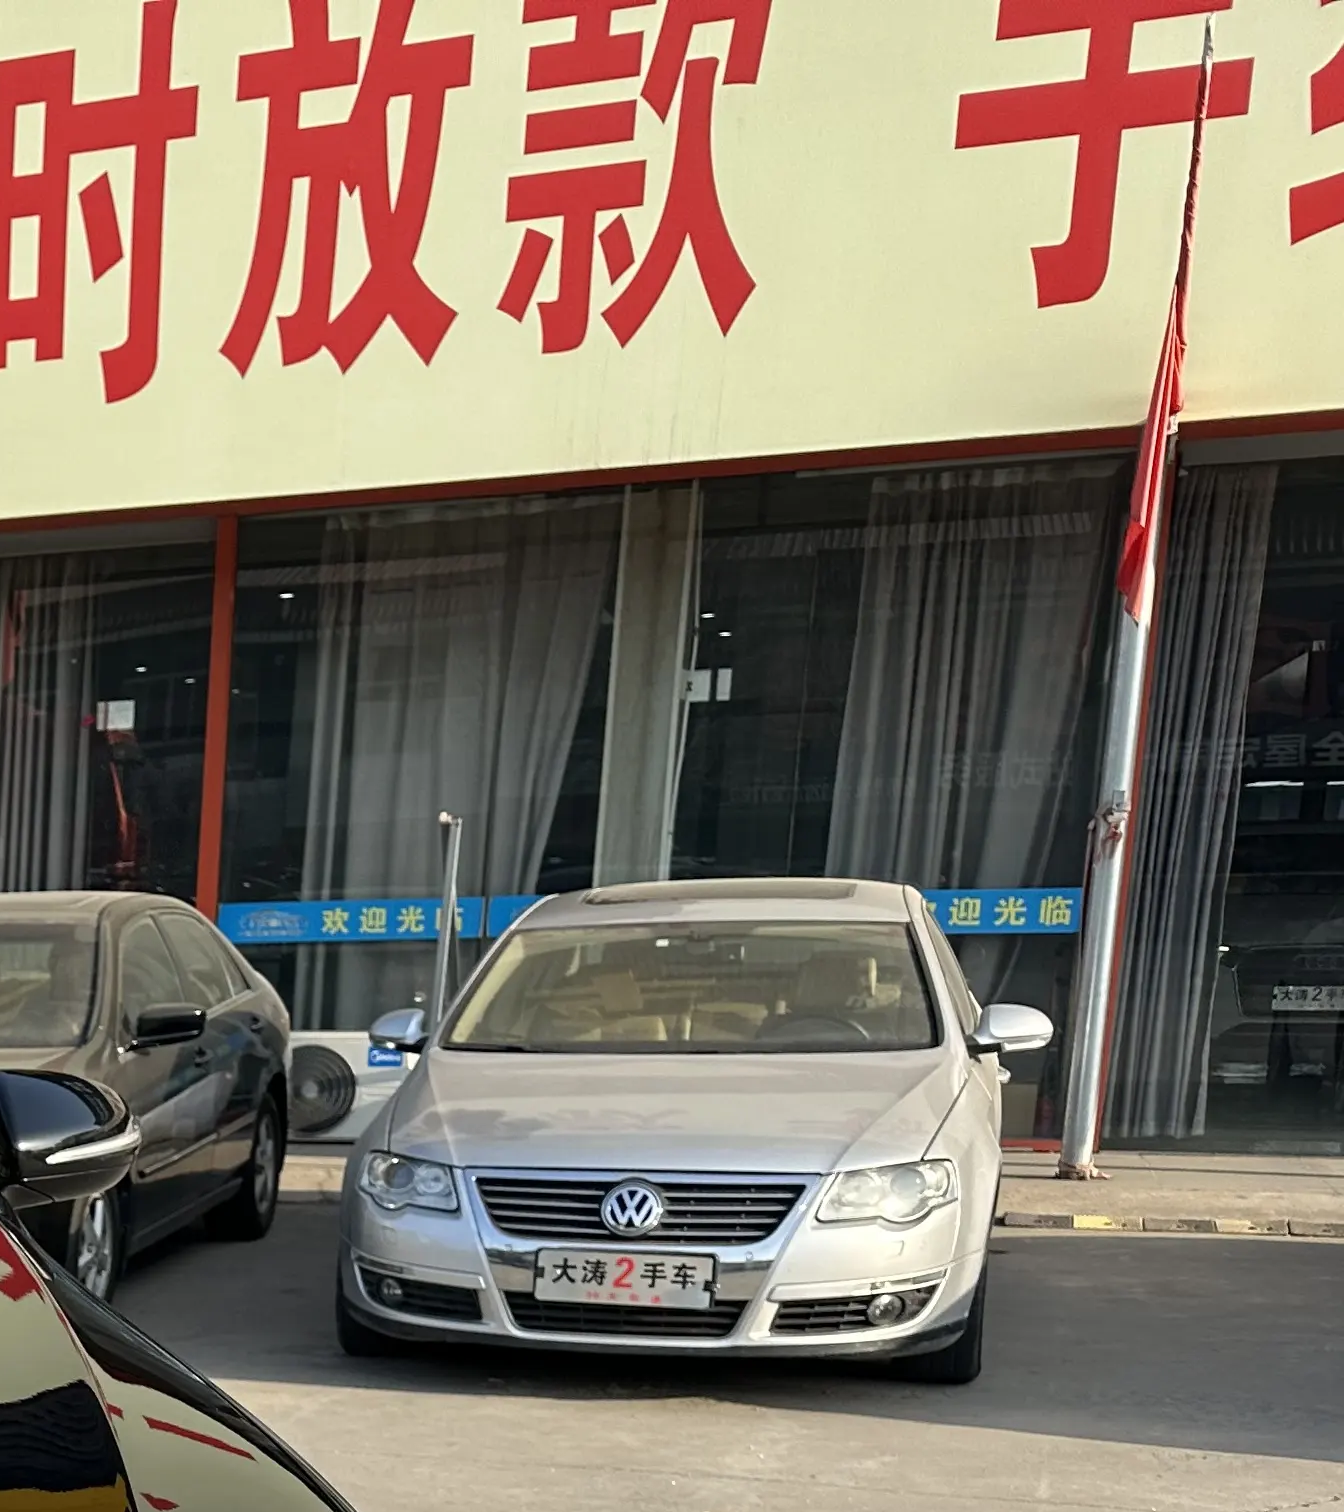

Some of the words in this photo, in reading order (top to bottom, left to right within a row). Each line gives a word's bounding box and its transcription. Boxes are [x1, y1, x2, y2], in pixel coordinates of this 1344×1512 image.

[925, 895, 1072, 926] 迎光临
[552, 1256, 697, 1289] 大涛2手车
